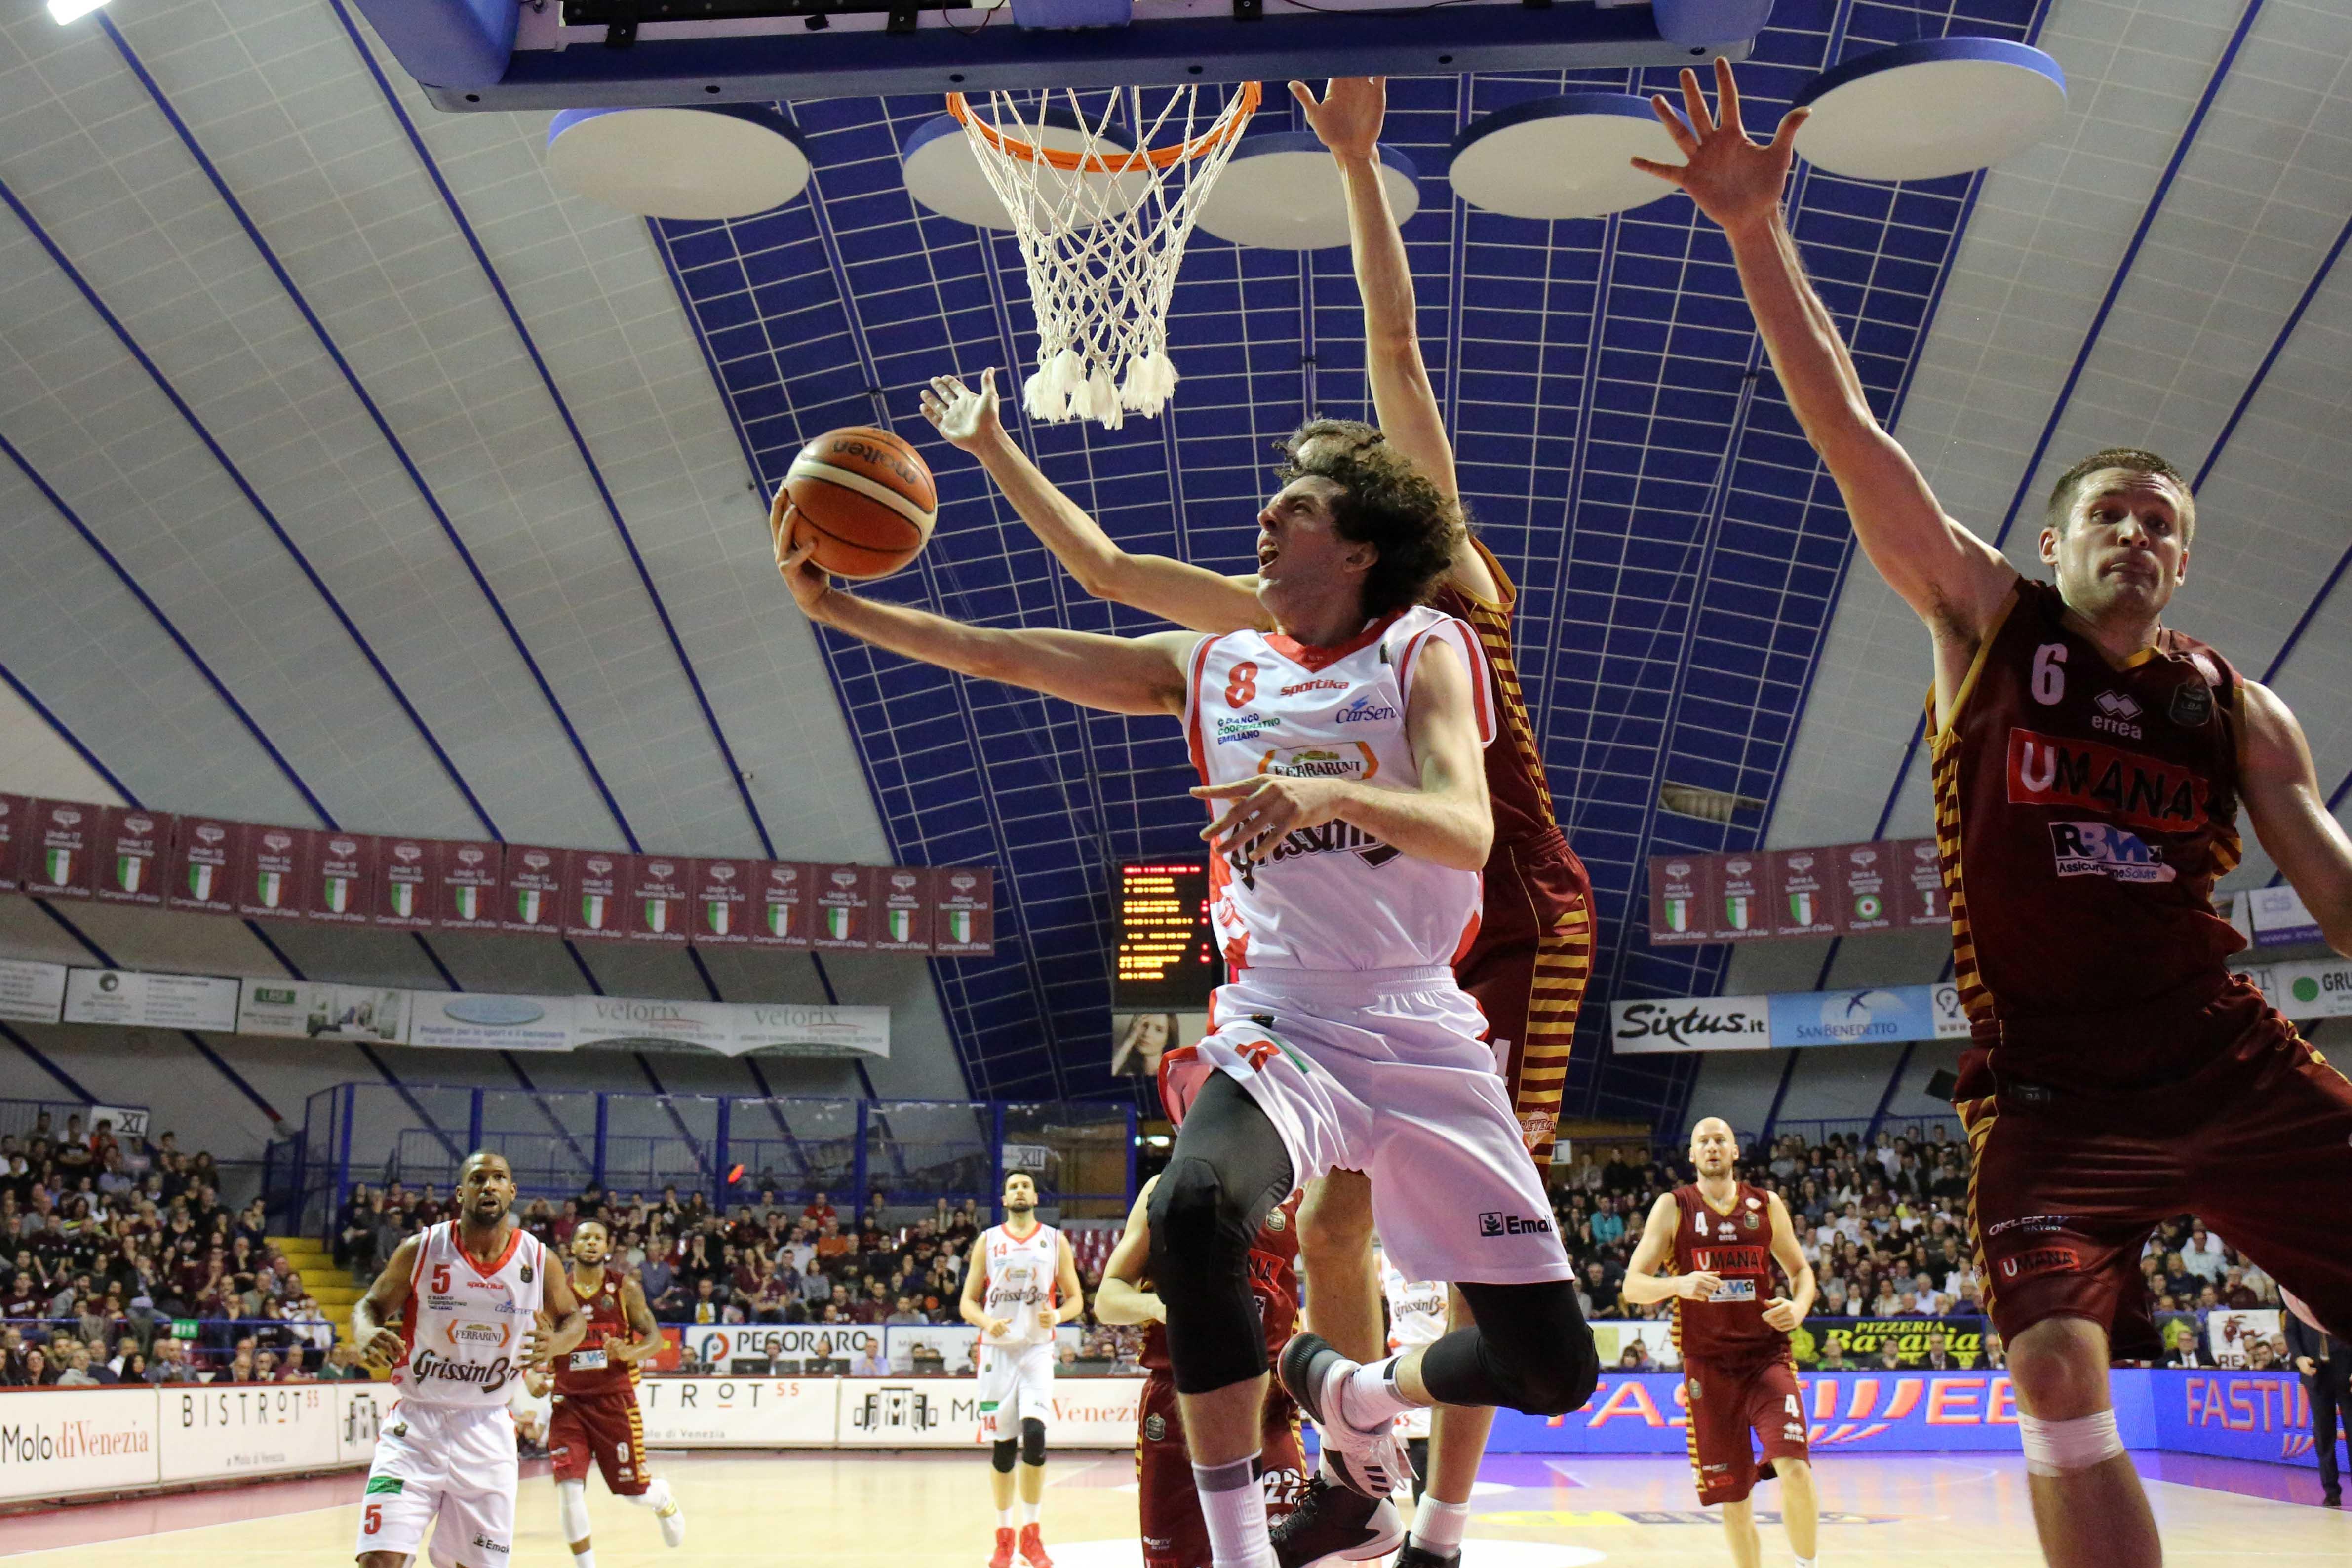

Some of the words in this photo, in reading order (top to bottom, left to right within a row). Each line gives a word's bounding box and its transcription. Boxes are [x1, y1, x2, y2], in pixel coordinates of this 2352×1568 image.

[1225, 661, 1258, 709] 8
[2031, 643, 2068, 706] 6
[1280, 679, 1350, 697] sportika
[2091, 715, 2142, 740] errea
[1275, 761, 1361, 778] FERRARINI
[2021, 741, 2197, 822] UMANA
[2051, 823, 2149, 864] RBM
[1695, 1211, 1709, 1236] 4
[993, 1242, 1007, 1258] 14
[1697, 1251, 1759, 1271] UMANA
[432, 1264, 451, 1294] 5
[455, 1329, 502, 1342] FERRARINI
[1855, 1322, 1945, 1333] PIZZERIA
[737, 1329, 869, 1352] PEGORARO
[306, 1390, 319, 1408] 55
[776, 1382, 800, 1397] 55
[1052, 1397, 1138, 1422] Venezi
[1784, 1394, 1800, 1418] 4
[983, 1415, 997, 1432] 14
[2, 1424, 53, 1463] Molo
[616, 1441, 630, 1464] 0
[1263, 1467, 1301, 1504] 22
[364, 1503, 382, 1535] 5
